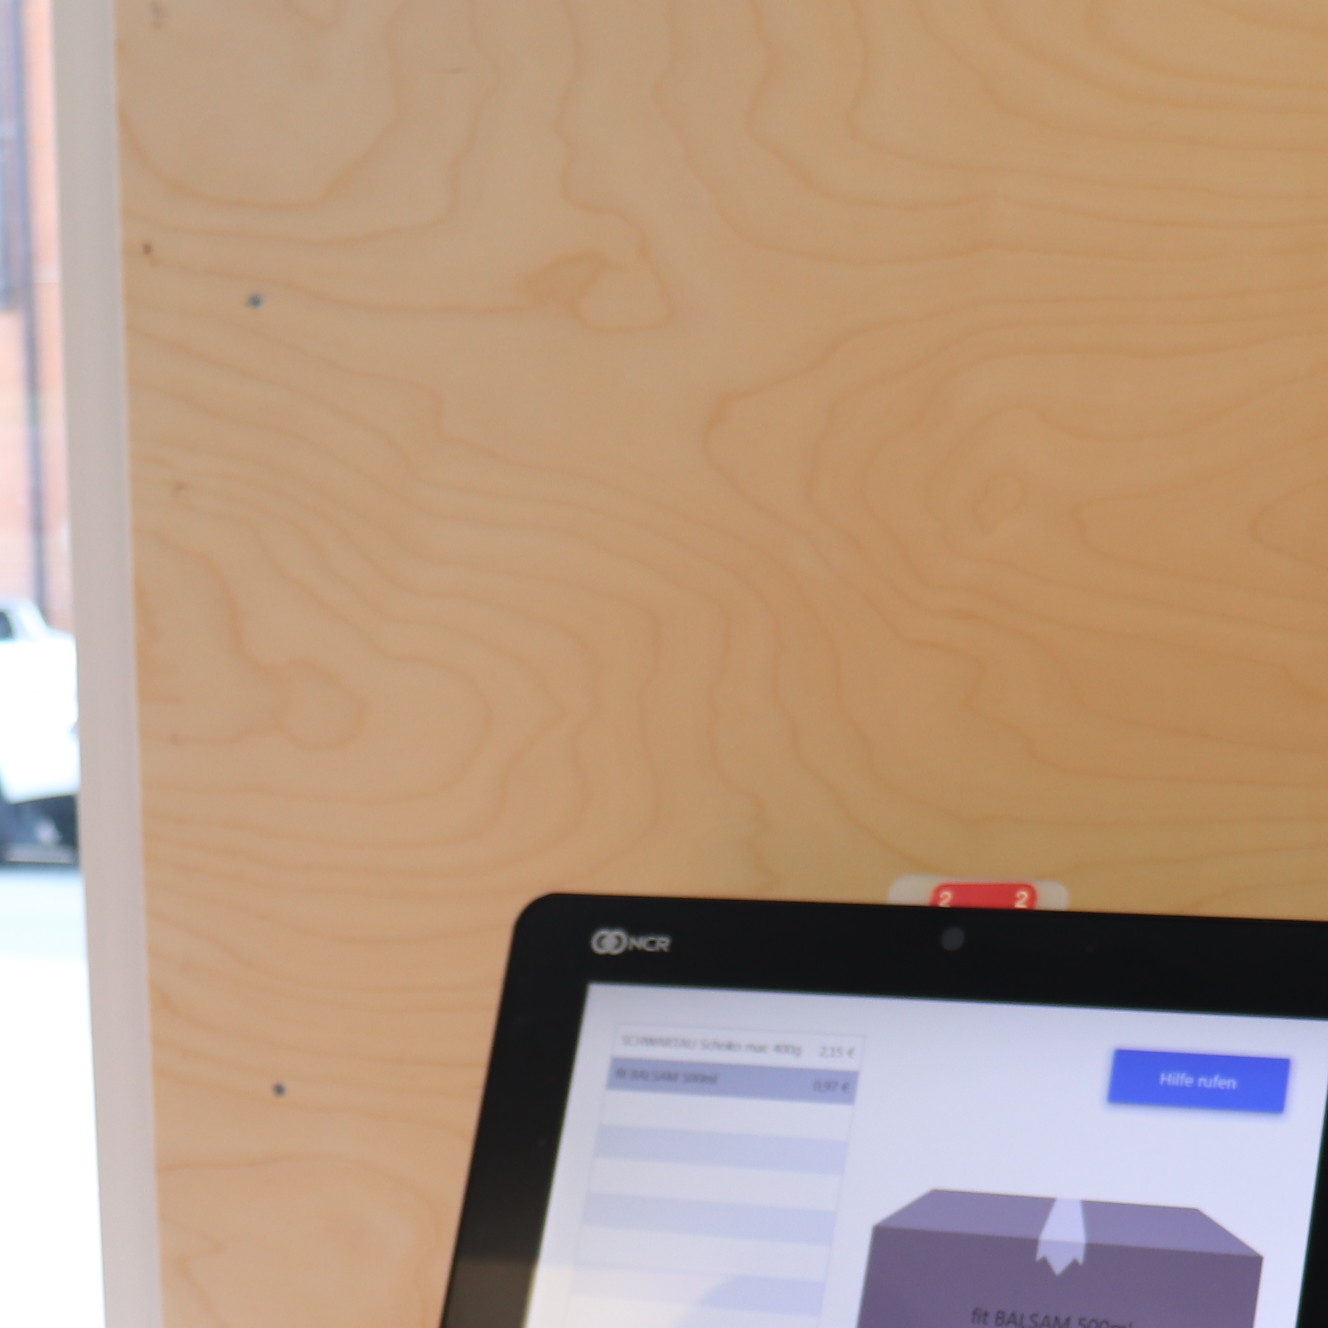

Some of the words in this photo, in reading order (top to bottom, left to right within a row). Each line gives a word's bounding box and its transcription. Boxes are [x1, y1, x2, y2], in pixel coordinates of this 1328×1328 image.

[629, 934, 671, 952] NCR
[1159, 1072, 1194, 1088] Hilfe
[1198, 1073, 1237, 1090] rufen
[971, 1307, 989, 1326] fit
